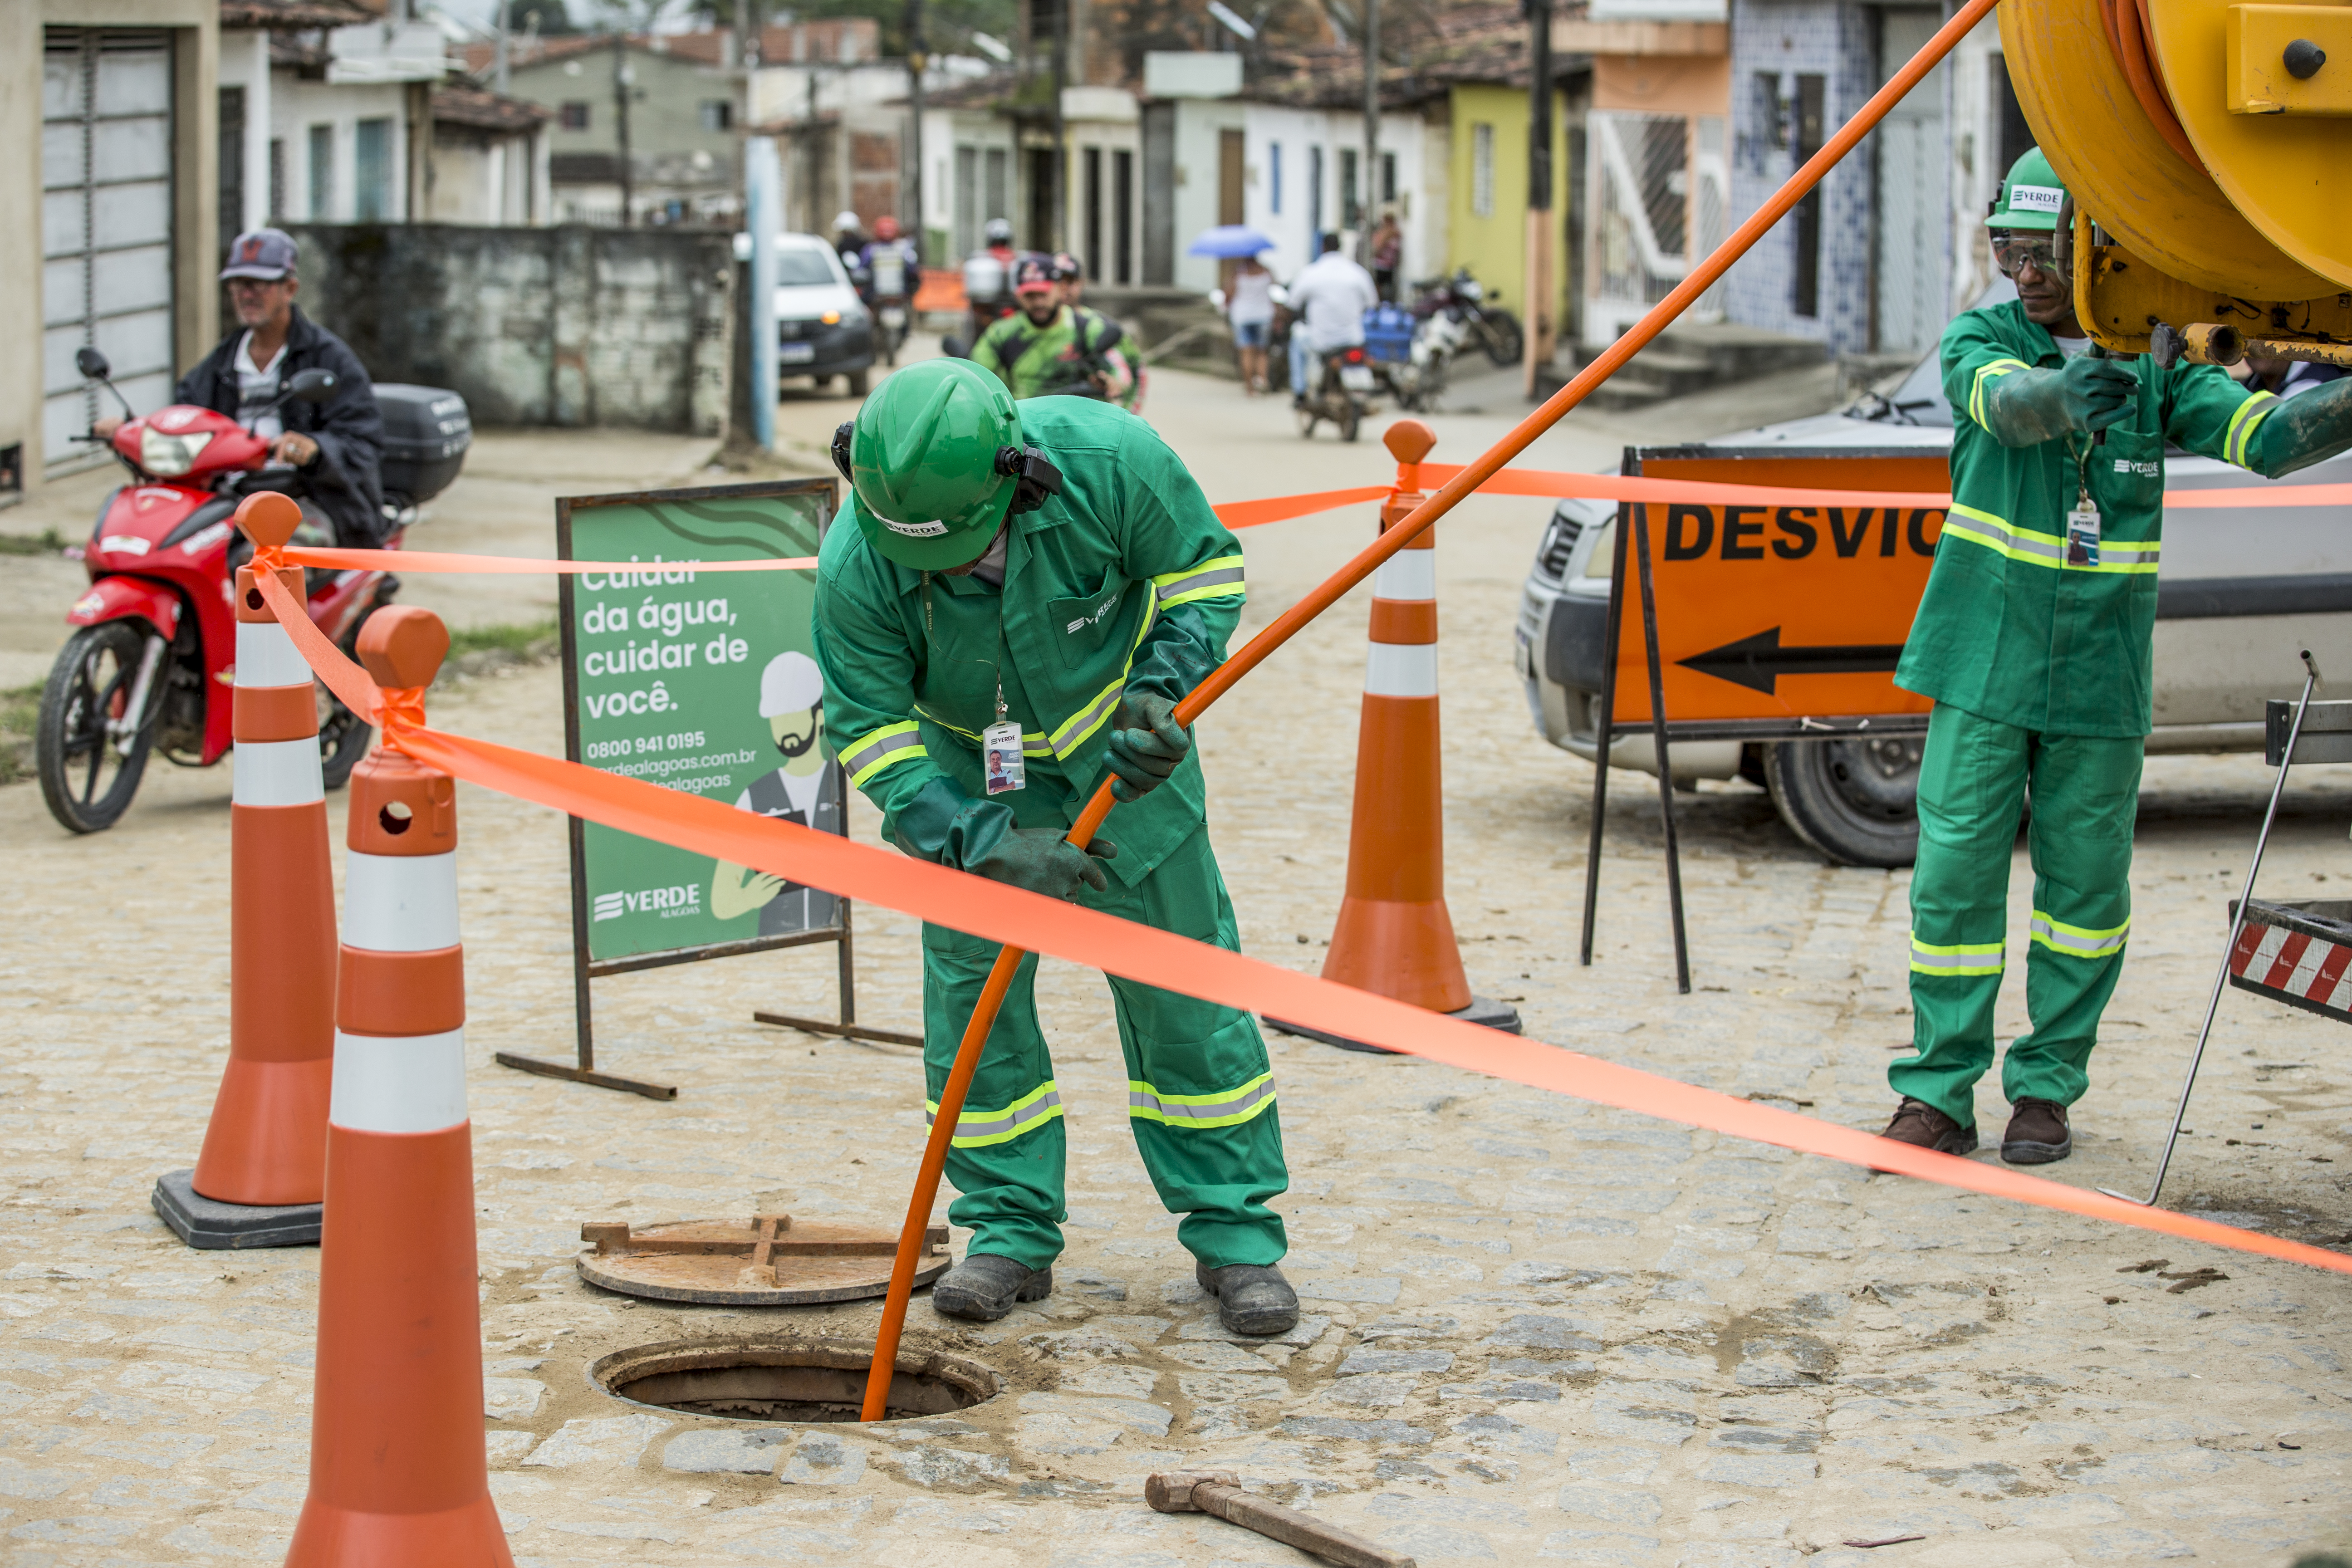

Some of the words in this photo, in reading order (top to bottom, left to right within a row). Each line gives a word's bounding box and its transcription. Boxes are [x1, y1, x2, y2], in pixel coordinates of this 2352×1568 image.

[2024, 191, 2058, 204] VERDE
[2130, 461, 2158, 473] VERDE
[894, 525, 940, 534] VERDE
[583, 602, 629, 634] da
[637, 595, 737, 637] água,
[1101, 598, 1117, 617] ALAGOAS
[584, 639, 697, 676] cuidar
[705, 633, 749, 665] de
[585, 680, 679, 719] você.
[587, 739, 632, 759] 0800
[635, 735, 663, 754] 941
[666, 730, 706, 750] 0195
[998, 735, 1015, 743] VERDE
[595, 749, 757, 777] rdealagoas.com.br
[624, 884, 701, 912] VERDE
[660, 906, 701, 918] ALAGOAS
